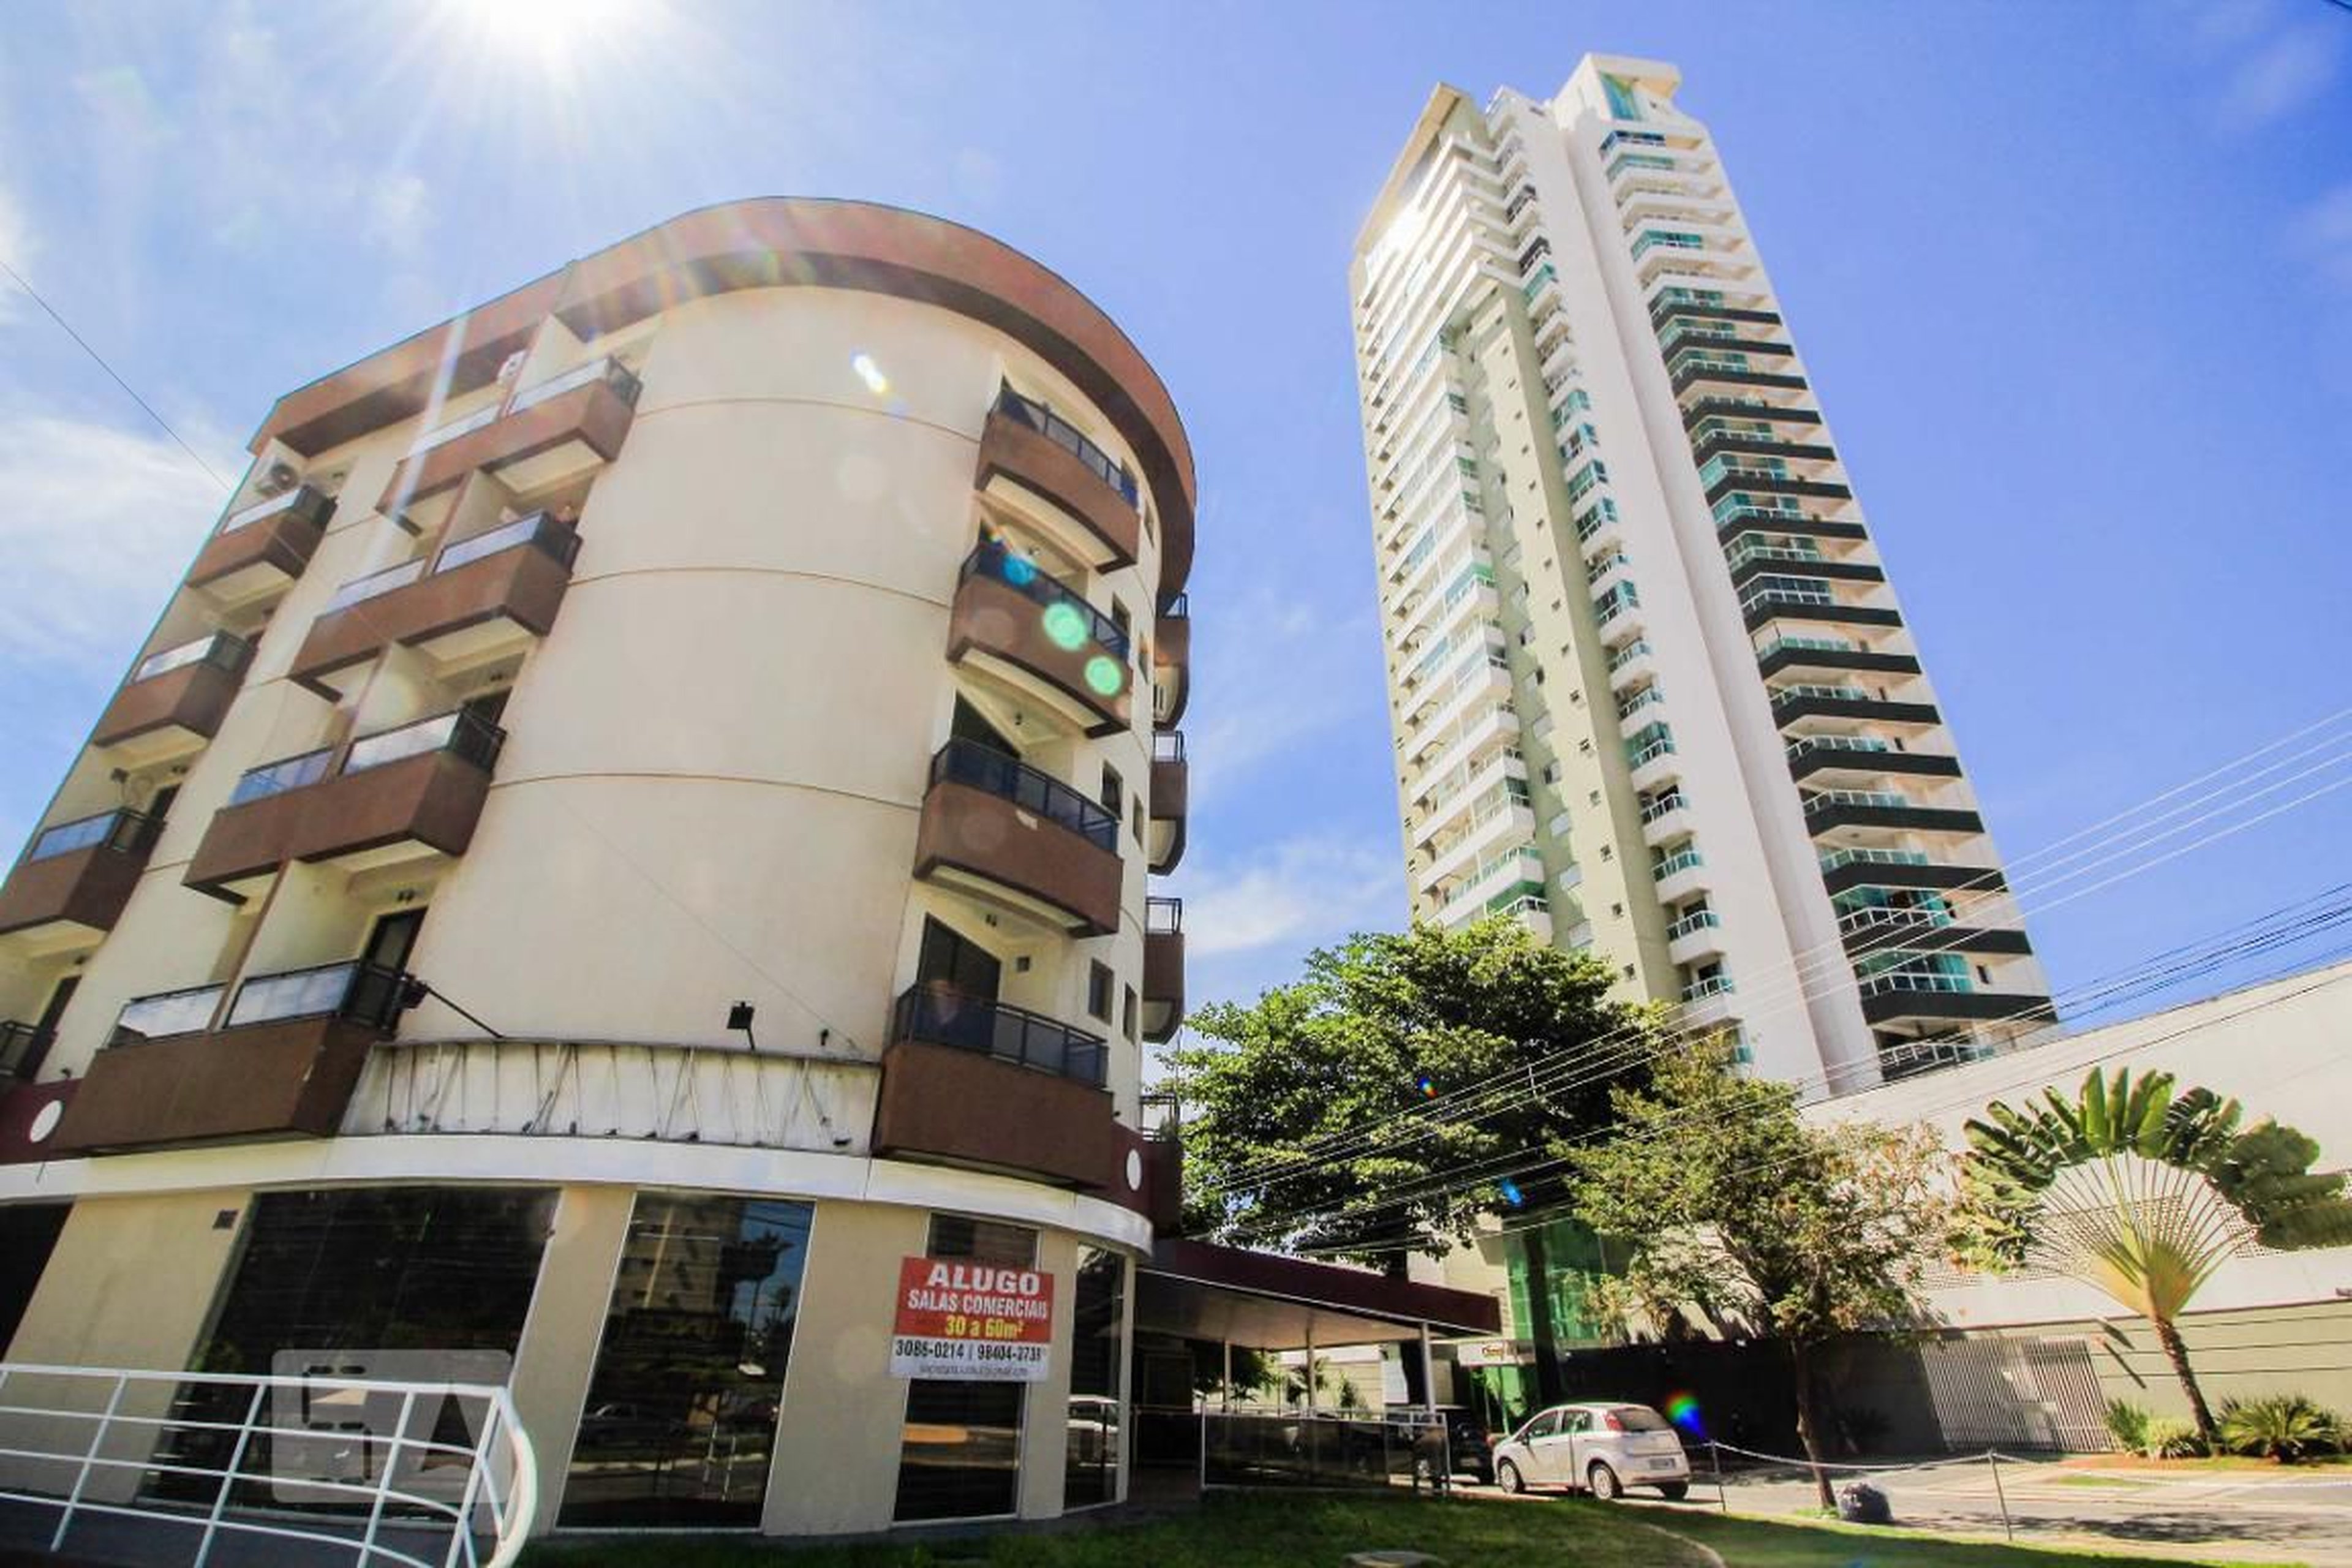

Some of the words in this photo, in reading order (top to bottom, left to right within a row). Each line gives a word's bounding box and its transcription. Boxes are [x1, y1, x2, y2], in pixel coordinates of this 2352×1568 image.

[927, 1263, 1040, 1295] ALUGO
[908, 1289, 958, 1311] SALAS
[945, 1314, 966, 1335] 30
[969, 1321, 981, 1337] a
